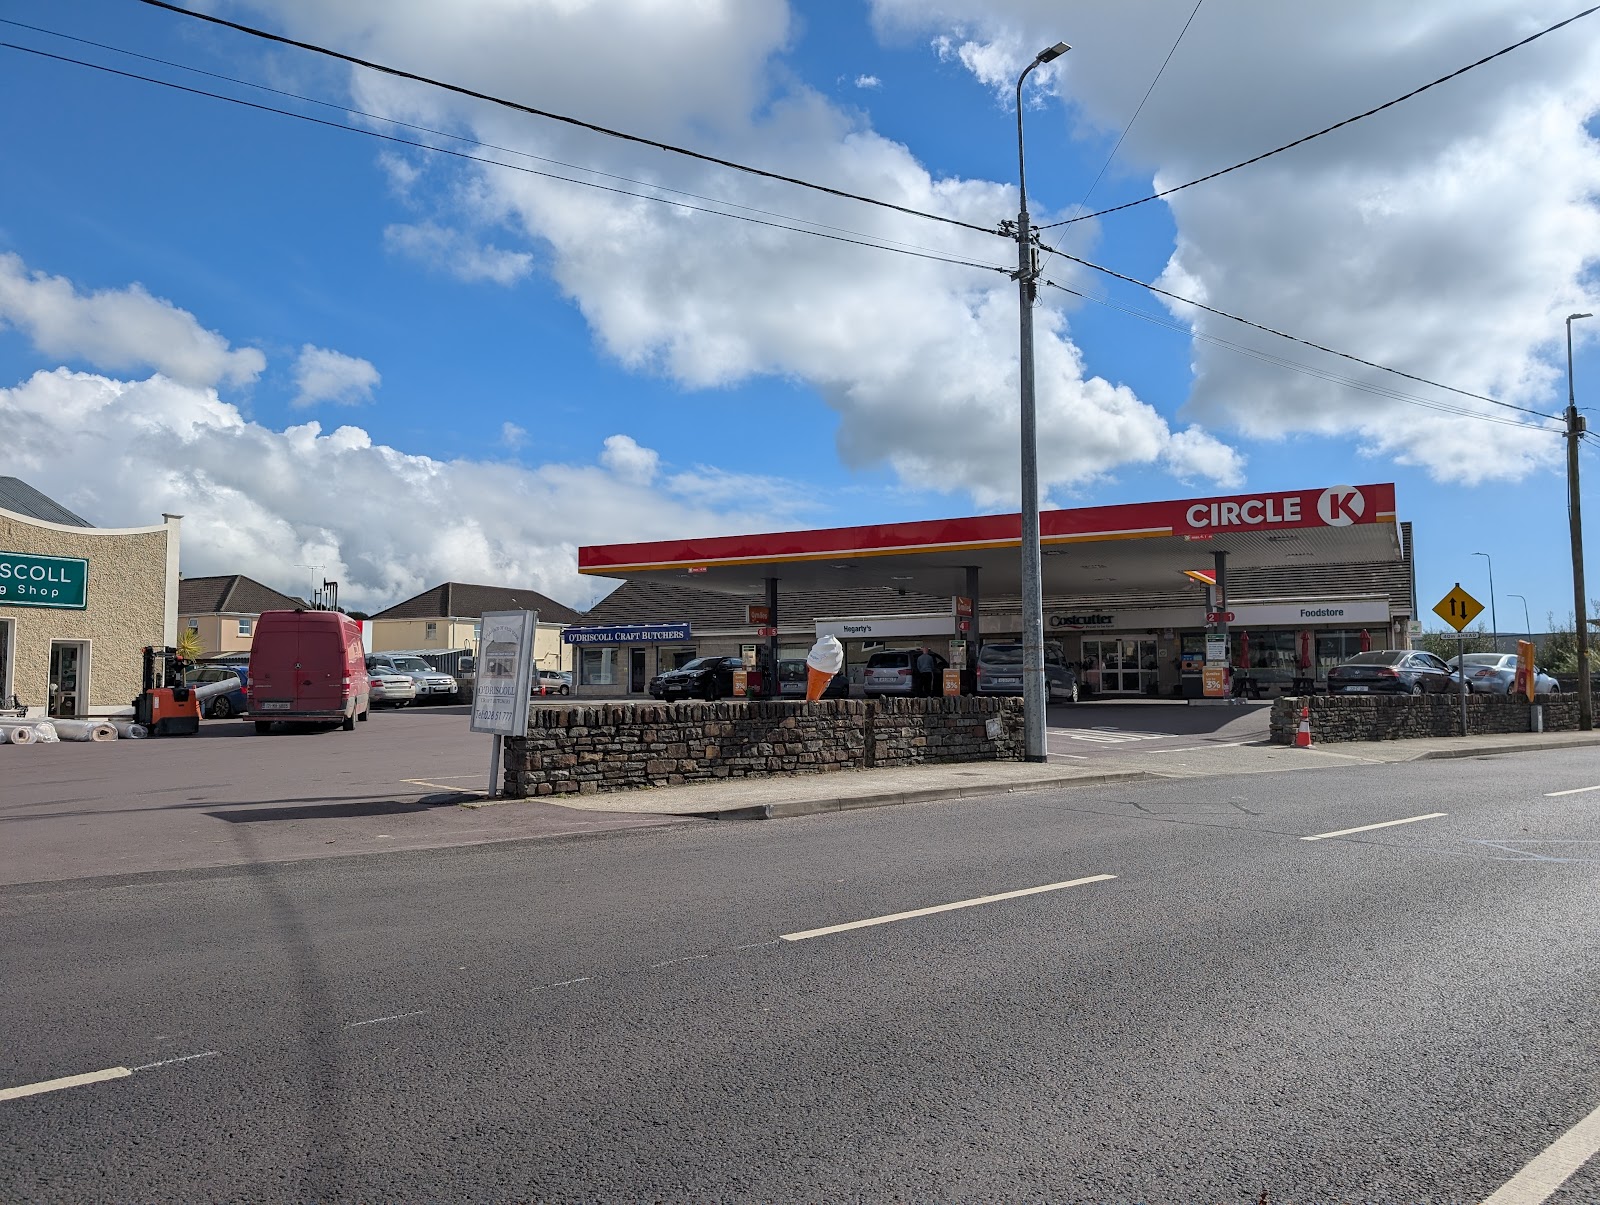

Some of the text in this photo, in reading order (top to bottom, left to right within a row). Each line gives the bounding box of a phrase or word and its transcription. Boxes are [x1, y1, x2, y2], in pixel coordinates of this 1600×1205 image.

[1186, 491, 1363, 528] CIRCLE K
[0, 563, 71, 582] SCOLL
[18, 584, 59, 598] Shop
[1228, 613, 1233, 621] 1
[1300, 608, 1344, 617] Foodstore
[1049, 614, 1114, 627] Costcutter
[771, 628, 776, 636] 5
[843, 625, 872, 633] Hegarty's
[568, 631, 684, 642] O'DRISCOLL CRAFT BUTCHERS
[478, 685, 515, 695] O'DRISCOLL
[1206, 681, 1221, 689] 3%
